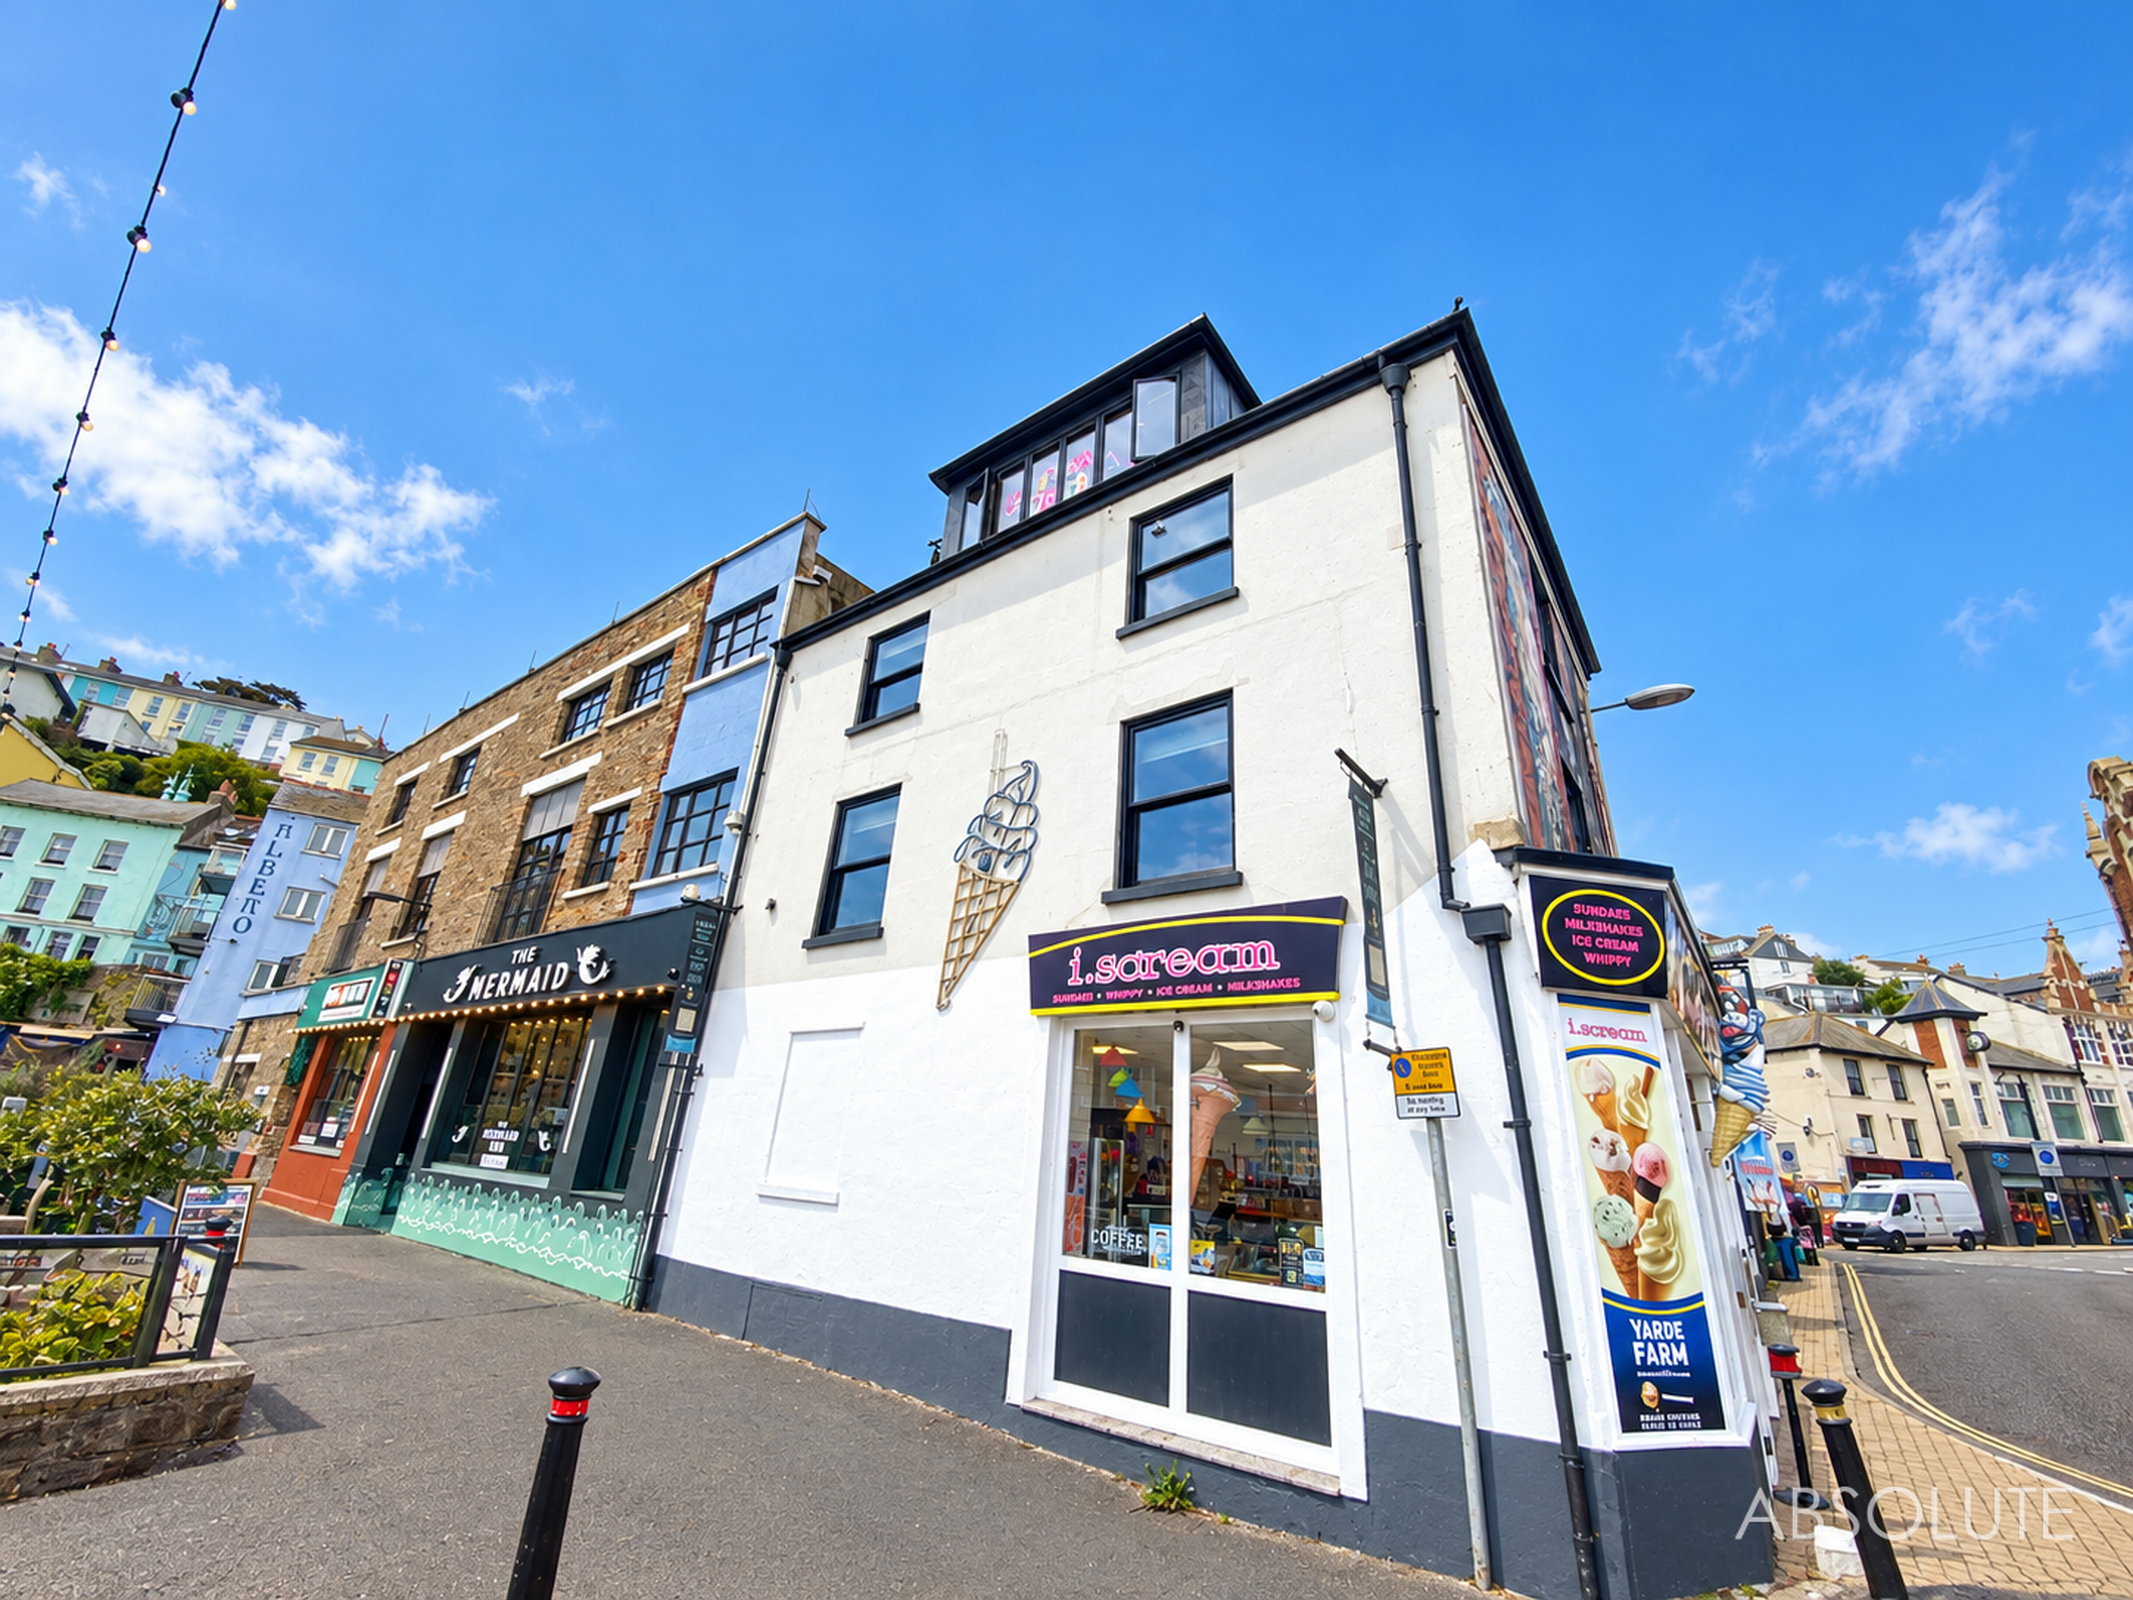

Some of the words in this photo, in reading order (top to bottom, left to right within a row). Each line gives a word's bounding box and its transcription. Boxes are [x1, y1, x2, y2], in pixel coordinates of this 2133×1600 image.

[1572, 934, 1592, 946] ICE
[511, 946, 538, 964] THE
[1583, 952, 1632, 967] WHIPPY
[467, 961, 570, 1002] MERMAID
[1567, 1017, 1648, 1043] i.scream
[1091, 1229, 1143, 1249] COFFEE
[1628, 1318, 1685, 1341] YARDE
[1632, 1341, 1689, 1367] FARM
